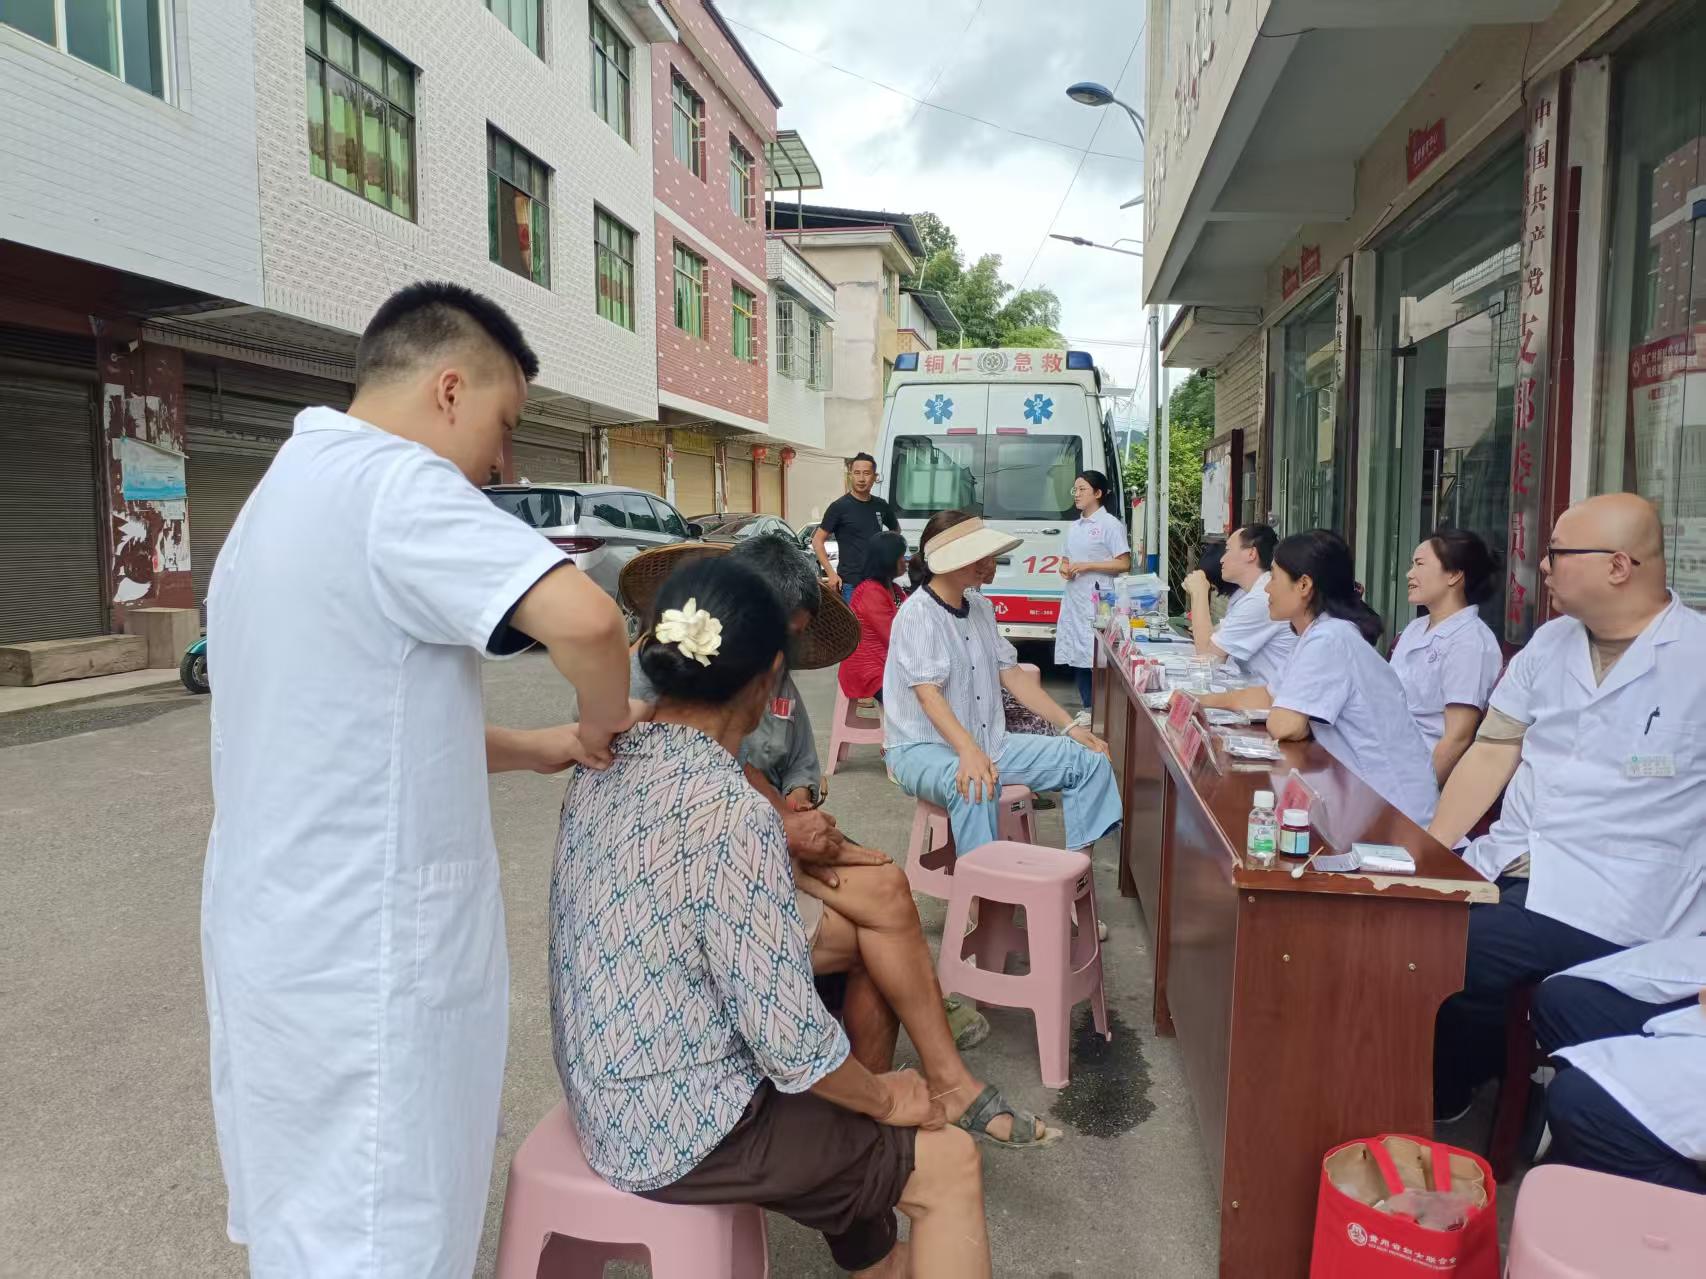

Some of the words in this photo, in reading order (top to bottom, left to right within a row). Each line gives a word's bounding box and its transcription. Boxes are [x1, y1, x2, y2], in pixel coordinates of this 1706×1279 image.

[924, 353, 973, 374] 铜仁
[1012, 352, 1064, 373] 急救
[1022, 555, 1069, 574] 12
